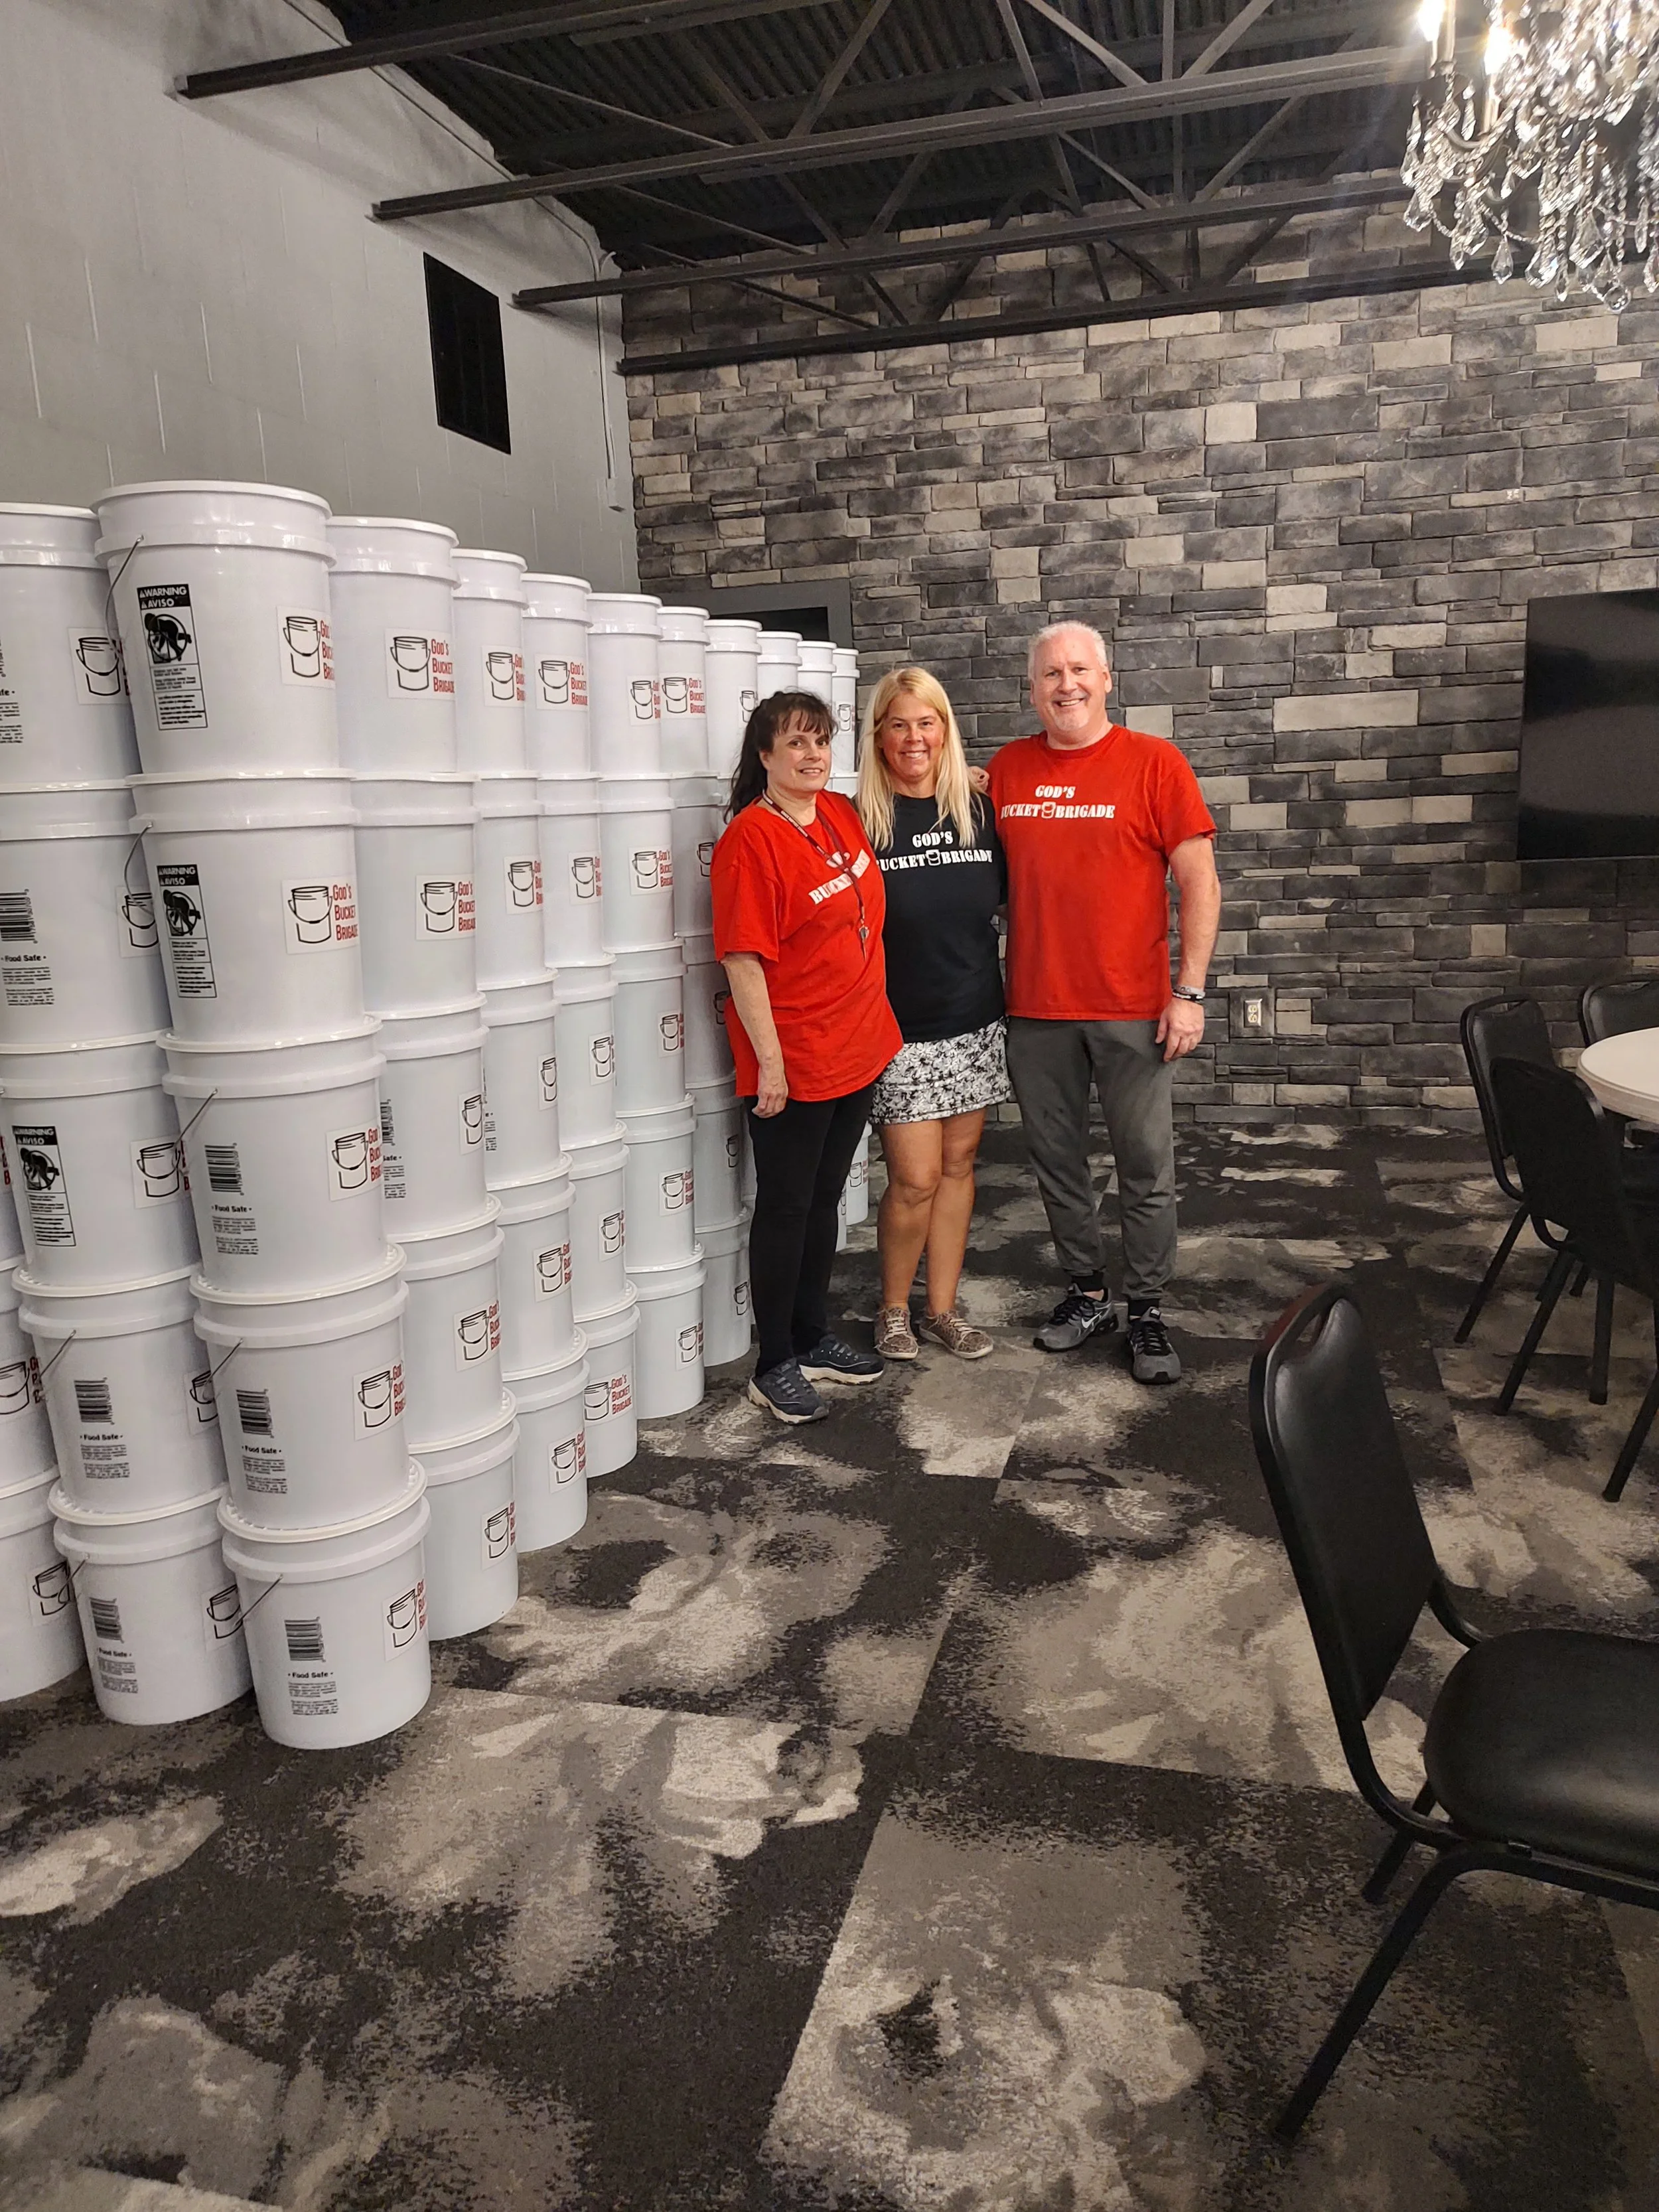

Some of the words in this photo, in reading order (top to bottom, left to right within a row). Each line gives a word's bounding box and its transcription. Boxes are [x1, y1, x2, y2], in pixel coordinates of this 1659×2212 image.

[144, 586, 186, 597] WARNING
[147, 598, 174, 608] AVISO
[1035, 785, 1076, 798] GOD'S
[1054, 804, 1116, 818] BRIGADE
[912, 831, 953, 848] GOD'S
[876, 854, 926, 871] UCKET
